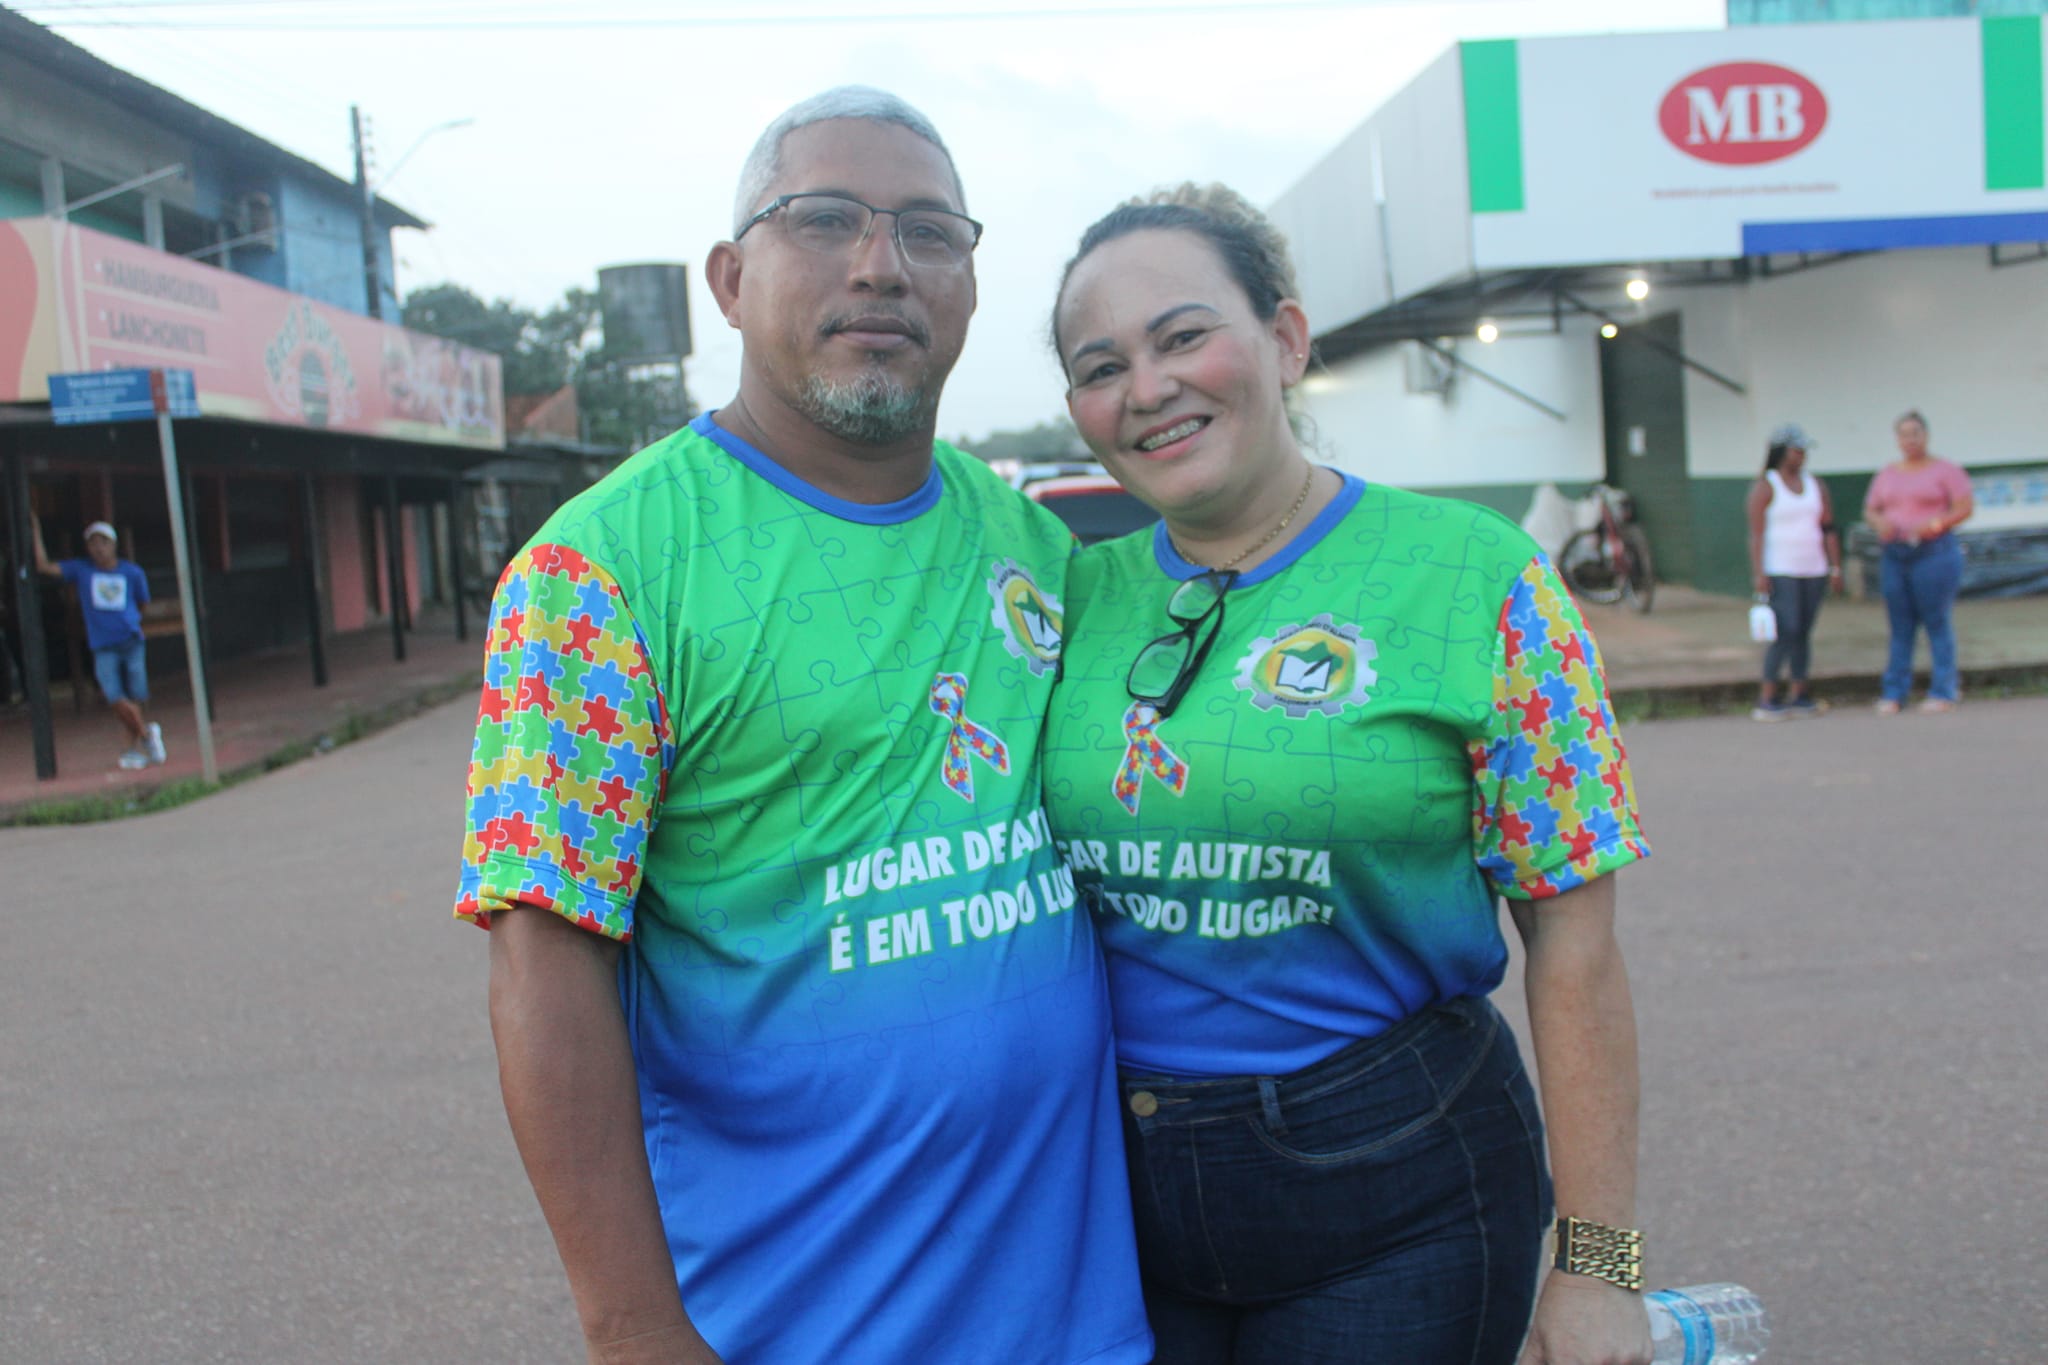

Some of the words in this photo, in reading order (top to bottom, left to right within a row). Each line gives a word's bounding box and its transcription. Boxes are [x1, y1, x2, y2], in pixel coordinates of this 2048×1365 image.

[1685, 83, 1806, 145] MB
[824, 836, 952, 905] LUGAR
[963, 822, 1007, 871] DE
[1118, 840, 1162, 878] DE
[1171, 841, 1332, 888] AUTISTA
[829, 914, 854, 971] É
[867, 908, 933, 964] EM
[942, 880, 1036, 945] TODO
[1200, 896, 1335, 938] LUGAR!
